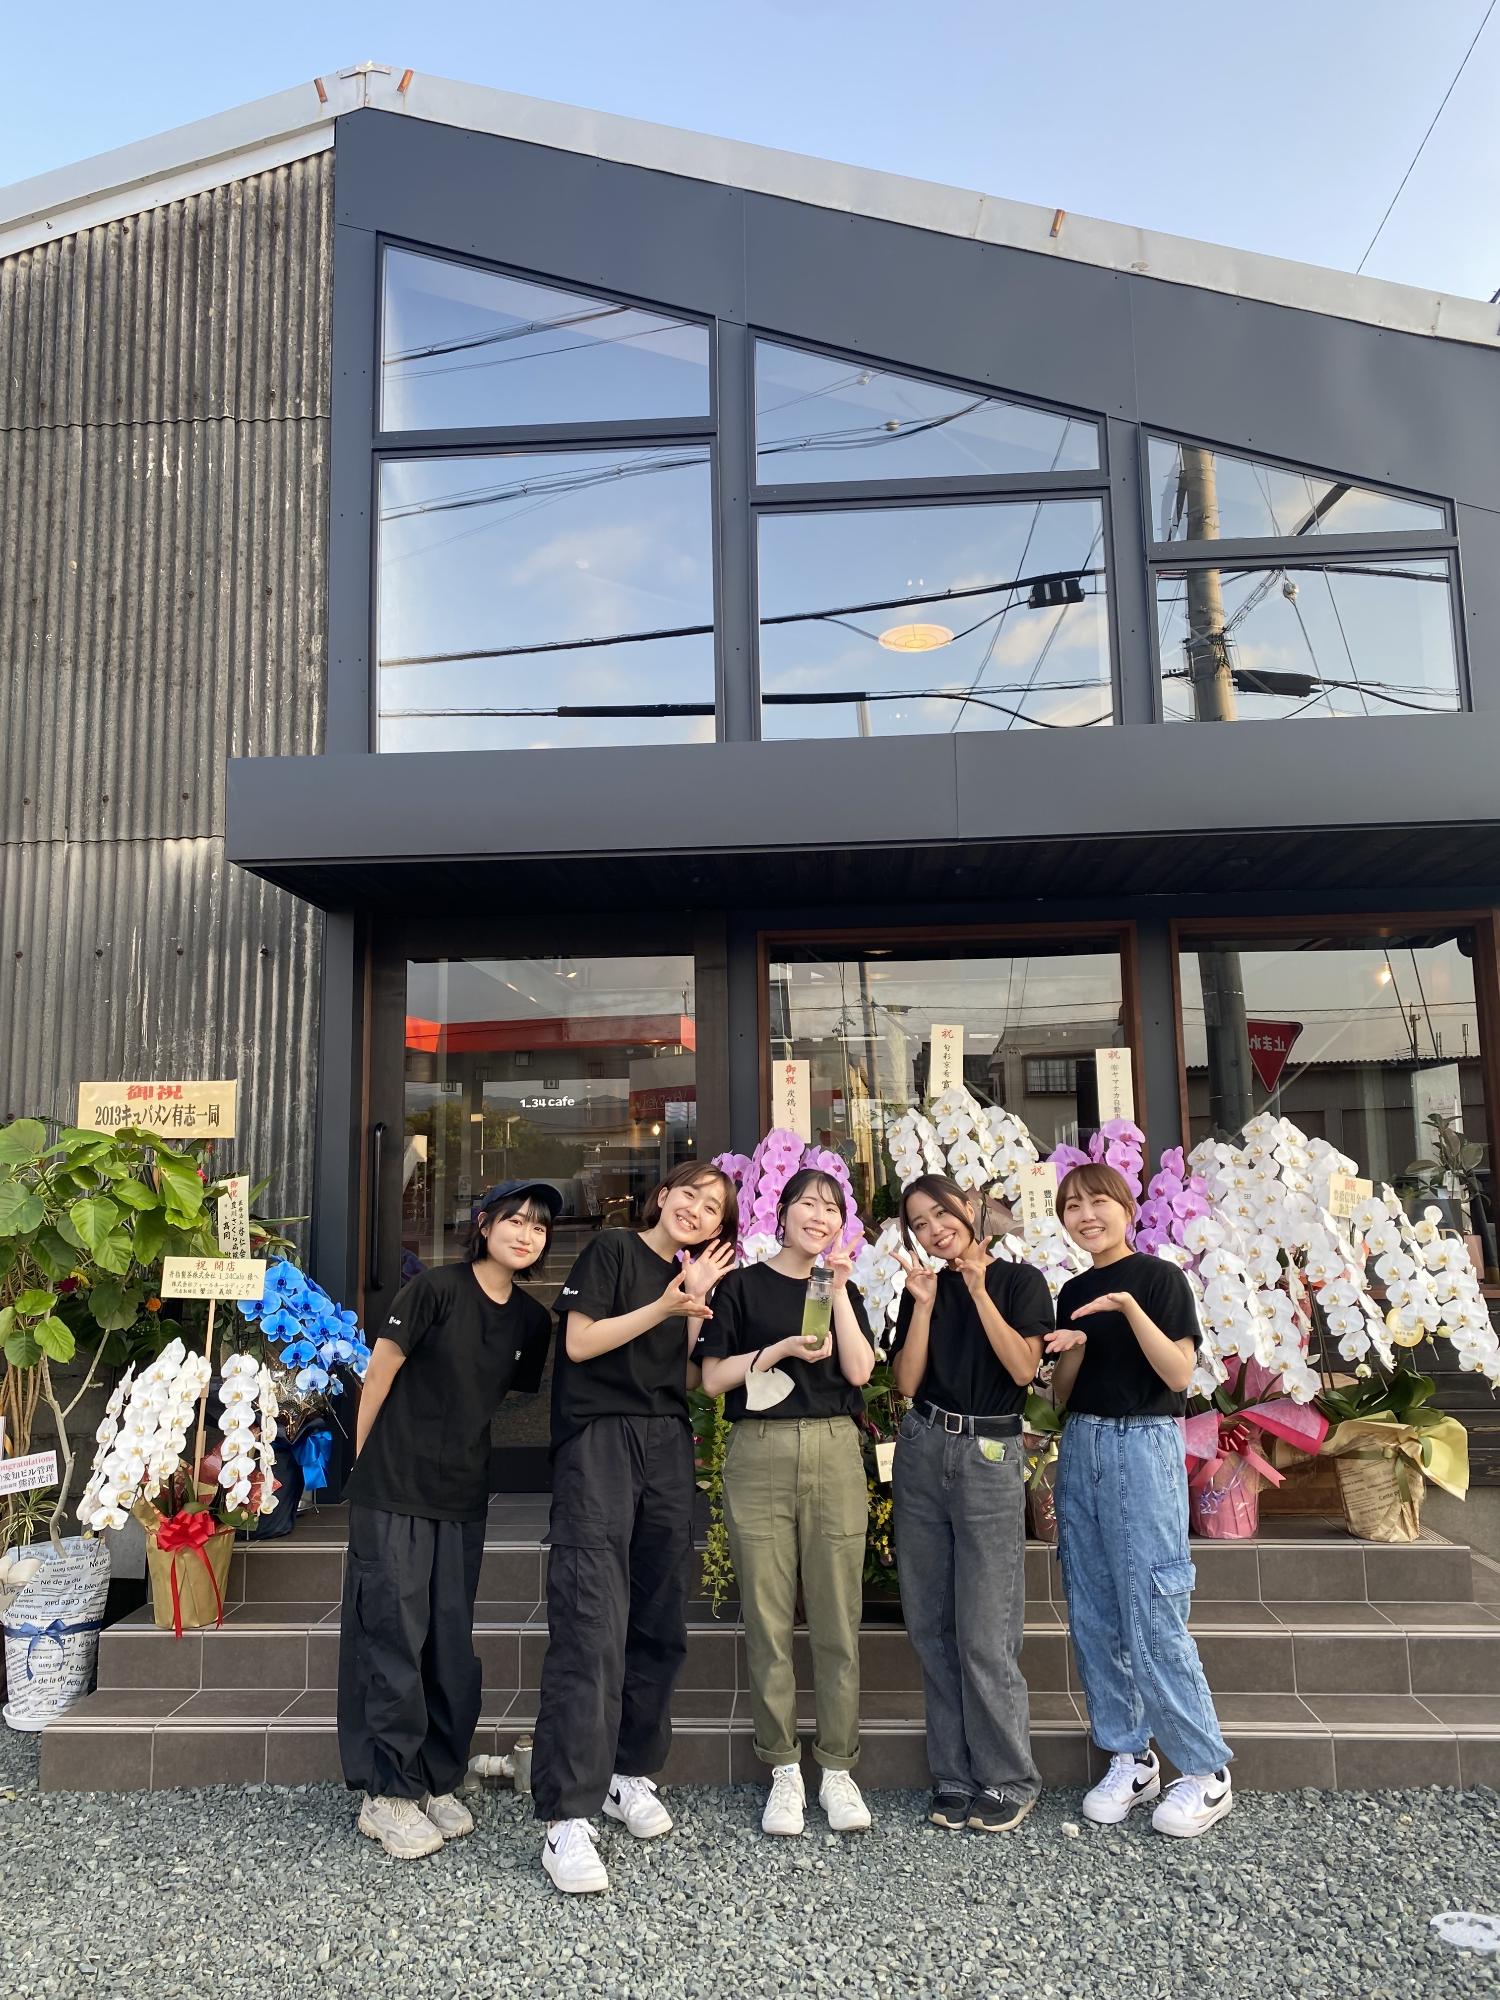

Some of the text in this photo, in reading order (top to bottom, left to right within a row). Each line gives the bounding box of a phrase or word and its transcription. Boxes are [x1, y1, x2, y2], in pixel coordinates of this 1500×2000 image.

[941, 1028, 954, 1039] 祝
[785, 1063, 797, 1085] 御祝
[127, 1084, 184, 1101] 御祝
[547, 1095, 576, 1107] cafe
[1030, 1166, 1046, 1177] 祝
[195, 1260, 236, 1272] 祝 開店
